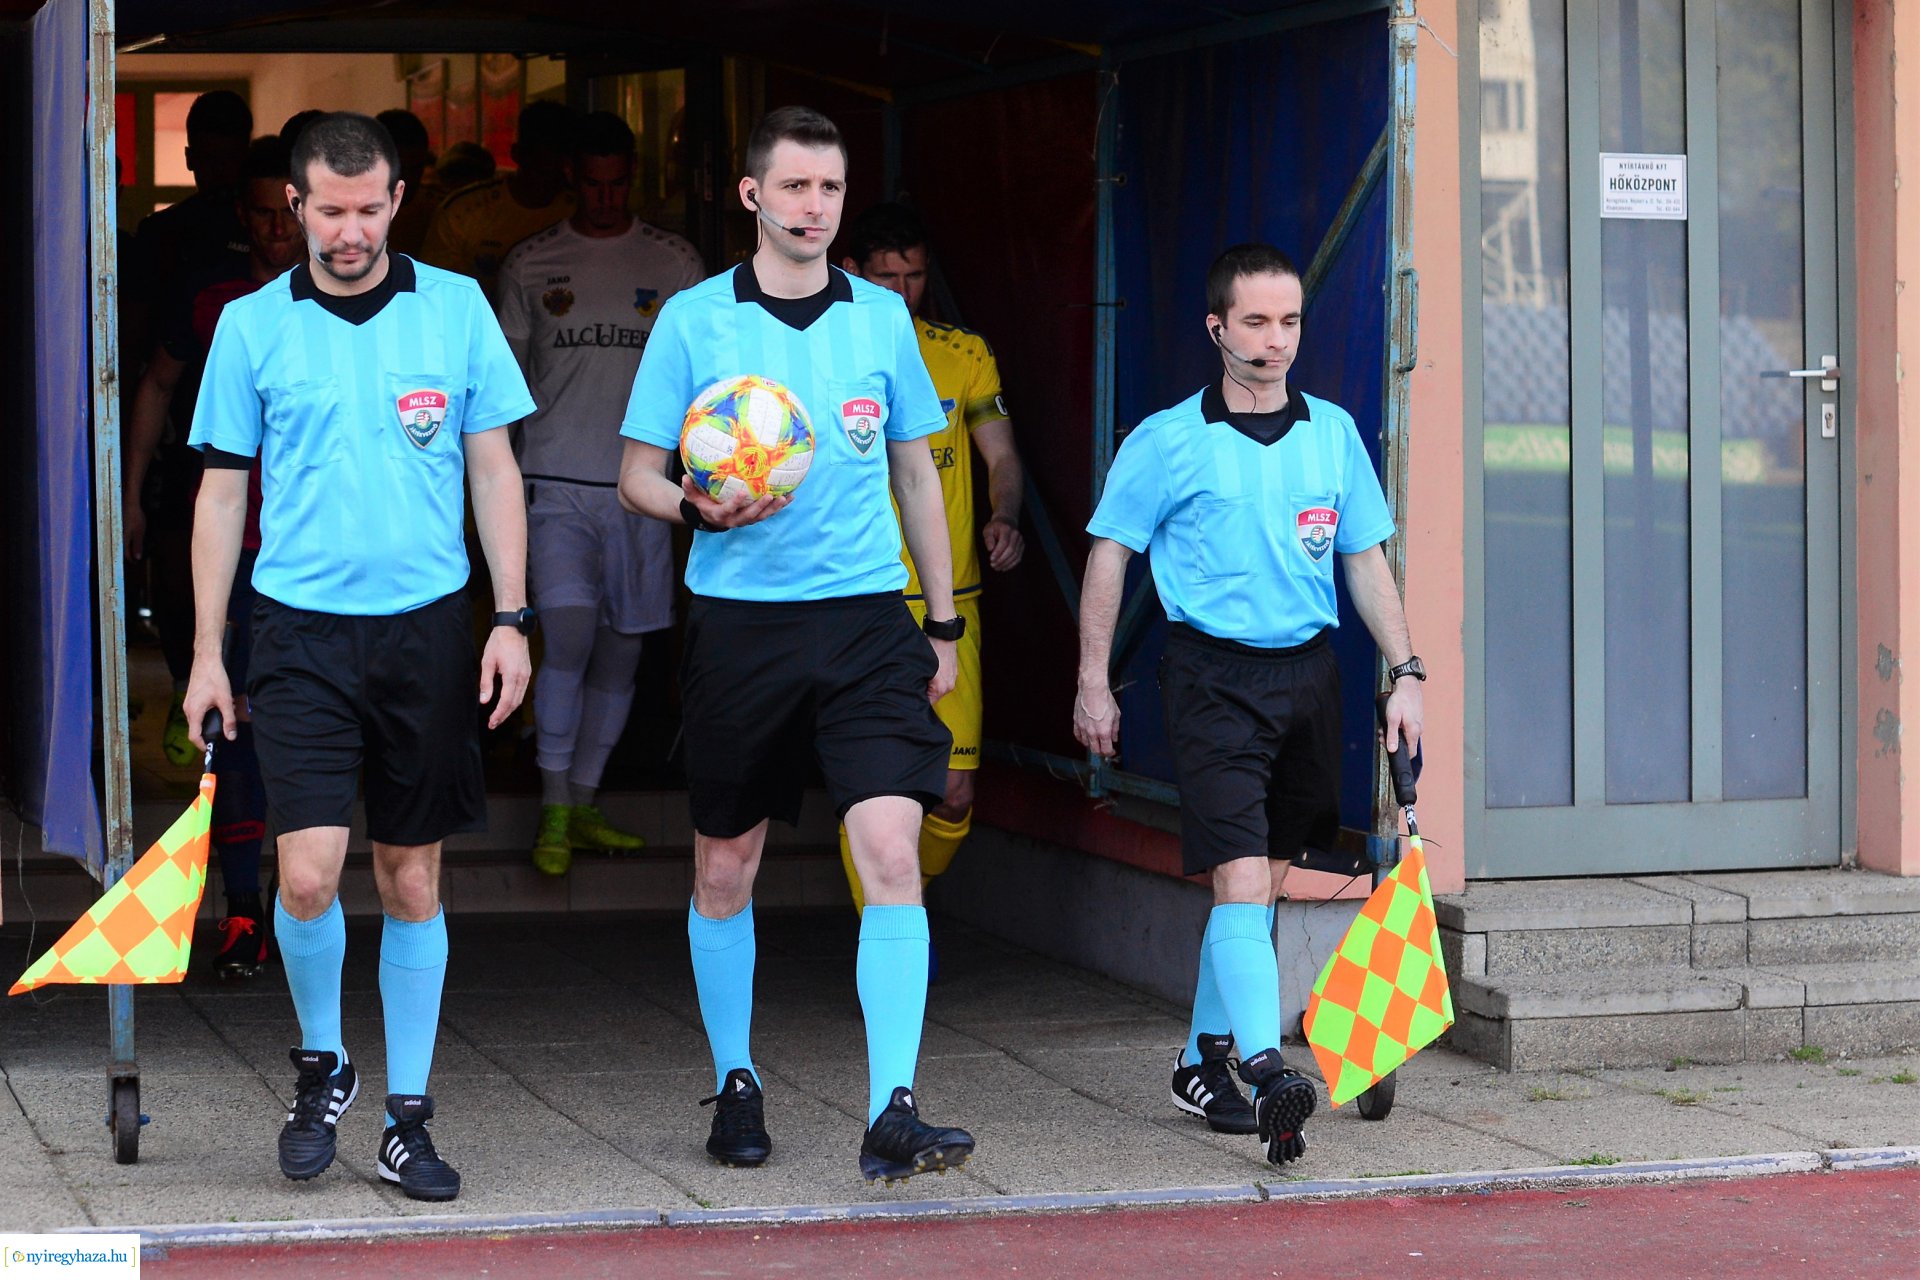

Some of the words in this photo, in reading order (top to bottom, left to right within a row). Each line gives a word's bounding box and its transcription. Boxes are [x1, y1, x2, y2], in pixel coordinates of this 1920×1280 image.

[1609, 173, 1677, 191] HŐKÖZPONT
[547, 275, 570, 286] JAKO
[409, 396, 437, 407] MLSZ
[852, 404, 875, 414] MLSZ
[1307, 513, 1332, 523] MLSZ
[952, 746, 977, 756] JAKO
